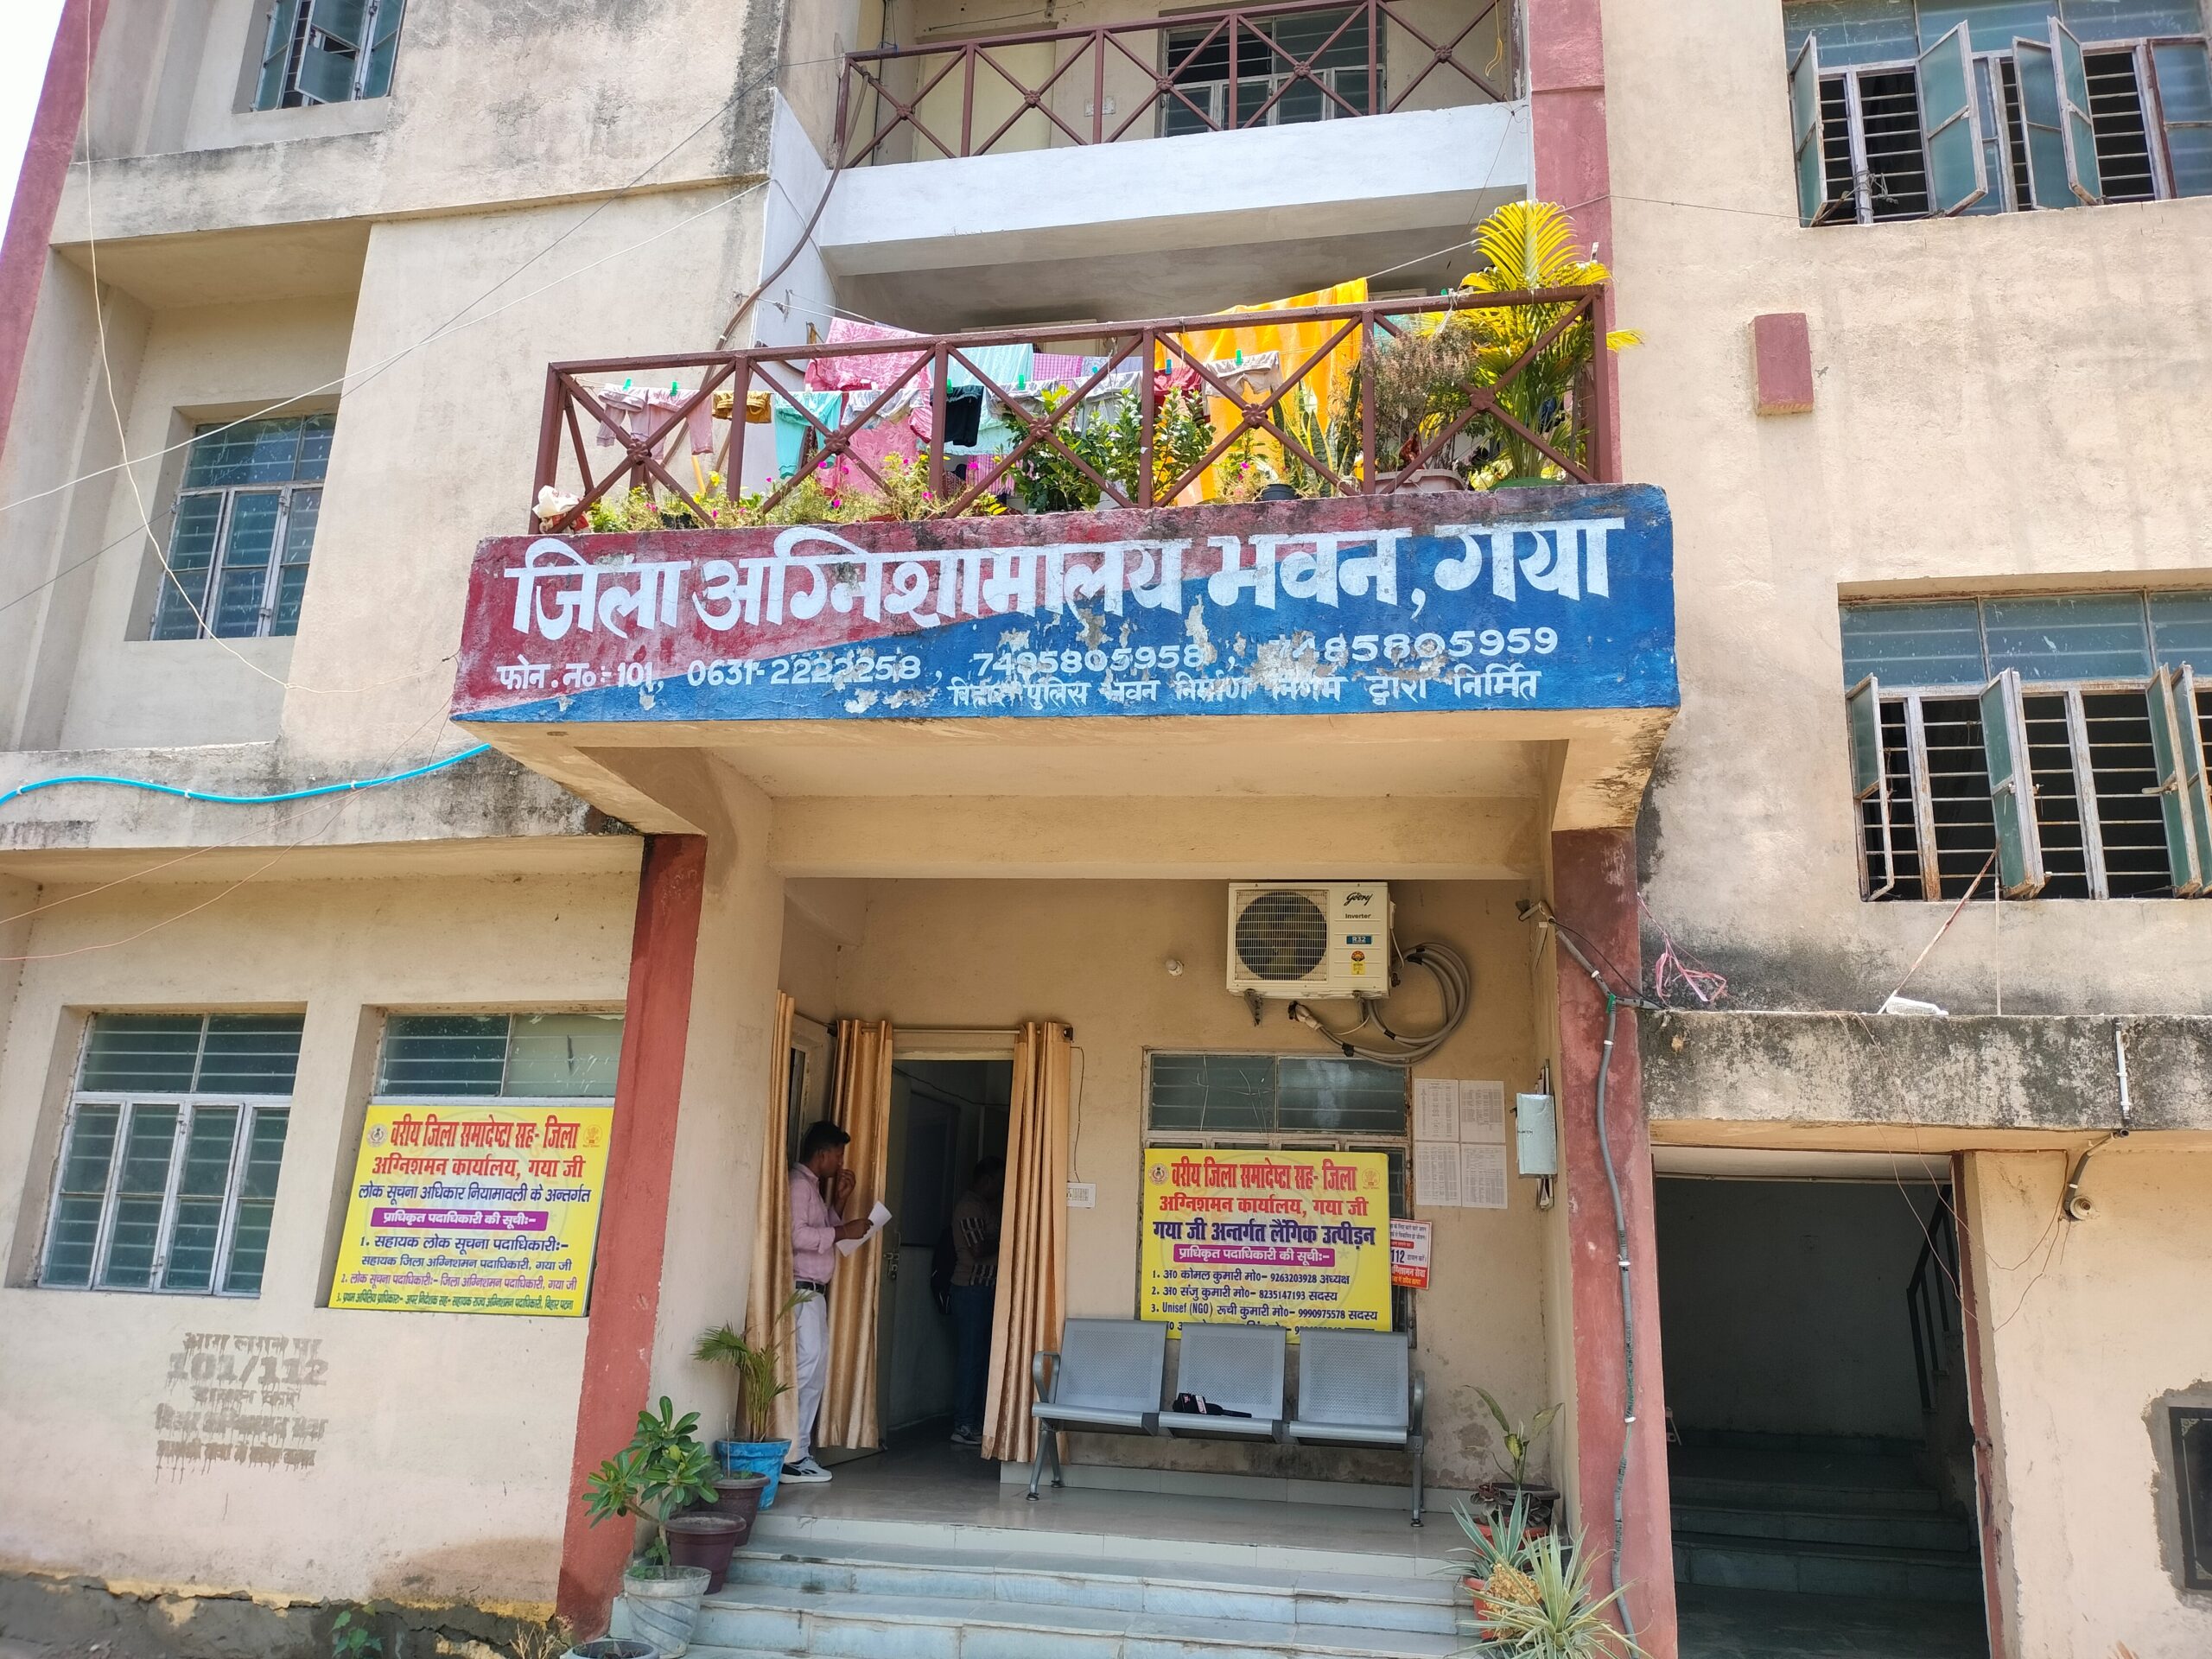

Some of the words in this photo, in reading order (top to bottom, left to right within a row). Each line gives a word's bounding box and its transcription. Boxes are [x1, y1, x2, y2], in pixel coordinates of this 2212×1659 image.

[504, 537, 692, 641] जिला
[691, 525, 1192, 632] अग्निशामालय
[1434, 517, 1625, 603] गया
[1024, 677, 1092, 711] पुलिस
[1364, 674, 1434, 706] द्वारा
[1453, 662, 1542, 702] निर्मित
[391, 1114, 423, 1147] वरीय
[423, 1114, 460, 1147] जिला
[460, 1114, 514, 1147] समादेष्टा
[543, 1115, 581, 1149] जिला
[372, 1152, 449, 1175] अग्निशमन
[452, 1154, 521, 1181] कार्यालय,
[528, 1160, 561, 1177] गया
[563, 1155, 586, 1178] जी
[1171, 1155, 1202, 1187] वरीय
[1204, 1156, 1237, 1188] जिला
[1239, 1157, 1292, 1189] समादेष्टा
[1321, 1158, 1357, 1192] जिला
[359, 1180, 385, 1198] लोक
[387, 1185, 419, 1205] सूचना
[420, 1181, 467, 1200] अधिकार
[530, 1184, 543, 1201] के
[545, 1184, 592, 1202] अन्तर्गत
[1159, 1192, 1234, 1212] अग्निशमन
[1236, 1194, 1306, 1217] कार्यालय,
[1312, 1200, 1344, 1215] गया
[1346, 1197, 1370, 1216] जी
[383, 1211, 427, 1226] प्राधिकृत
[428, 1211, 483, 1224] पदाधिकारी
[484, 1211, 501, 1224] की
[1153, 1221, 1183, 1239] गया
[1185, 1217, 1207, 1240] जी
[1211, 1218, 1267, 1242] अन्तर्गत
[1268, 1219, 1319, 1243] लैंगिक
[374, 1236, 421, 1248] सहायक
[423, 1234, 452, 1249] लोक
[454, 1238, 490, 1255] सूचना
[1179, 1245, 1221, 1262] प्राधिकृत
[1223, 1246, 1277, 1261] पदाधिकारी
[1279, 1248, 1294, 1261] की
[361, 1255, 398, 1266] सहायक
[400, 1254, 426, 1267] जिला
[427, 1255, 477, 1268] अग्निशमन
[536, 1262, 556, 1270] गया
[558, 1259, 572, 1271] जी
[350, 1271, 368, 1284] लोक
[370, 1274, 391, 1289] सूचना
[440, 1273, 461, 1287] जिला
[461, 1274, 503, 1287] अग्निशमन
[547, 1280, 565, 1290] गया
[566, 1276, 578, 1291] जी
[1180, 1268, 1211, 1281] कोमल
[1212, 1268, 1242, 1284] कुमारी
[1270, 1273, 1317, 1283] 9263203928
[1319, 1274, 1350, 1285] अध्यक्ष
[1201, 1285, 1230, 1301] कुमारी
[1259, 1290, 1306, 1300] 8235147193
[1308, 1292, 1338, 1301] सदस्य
[1162, 1302, 1186, 1313] Unisef
[1240, 1304, 1269, 1319] कुमारी
[1298, 1309, 1345, 1320] 9990975578
[1348, 1310, 1377, 1321] सदस्य
[168, 1352, 329, 1386] 101/112
